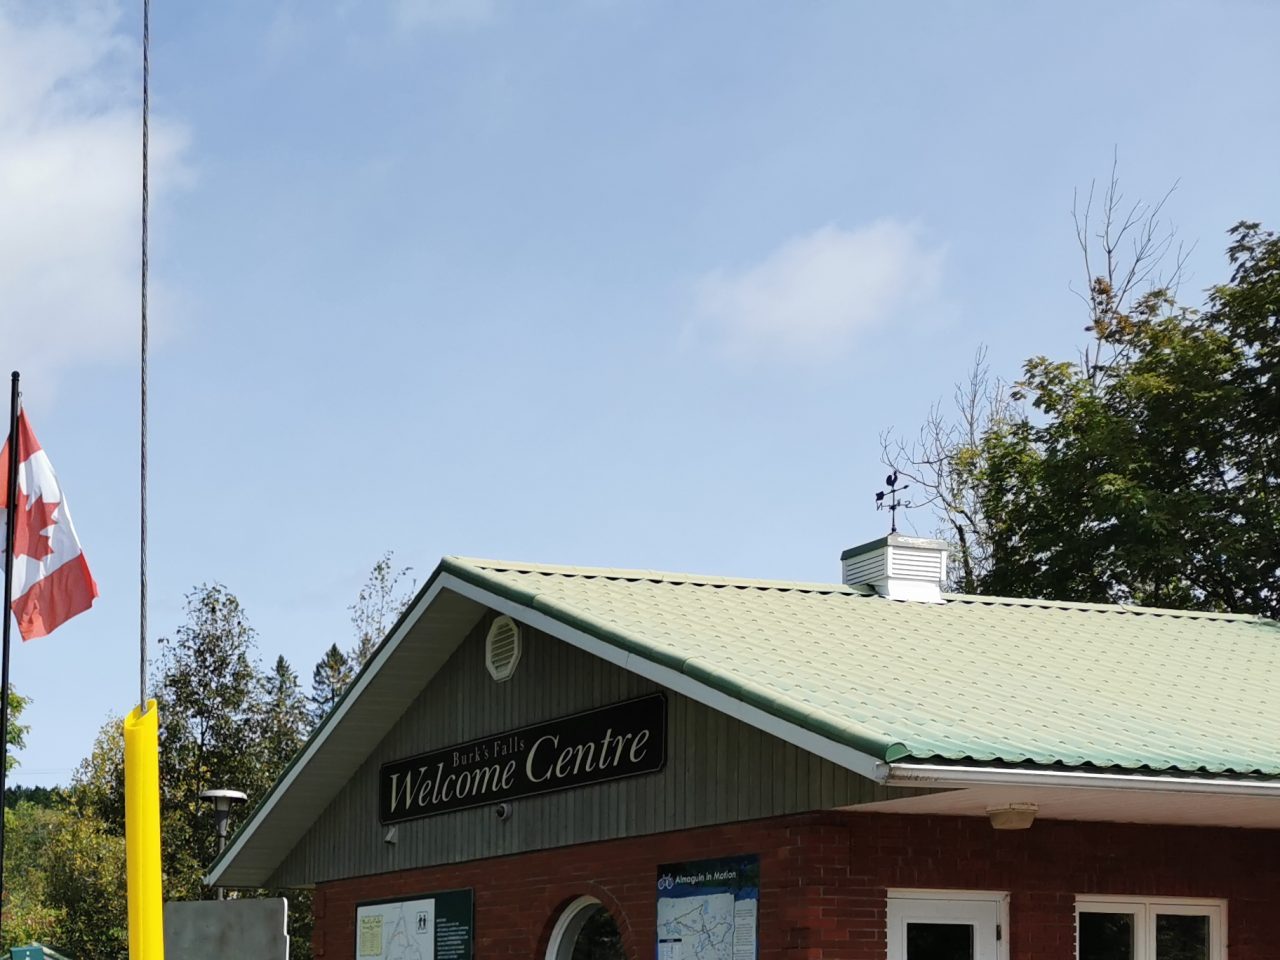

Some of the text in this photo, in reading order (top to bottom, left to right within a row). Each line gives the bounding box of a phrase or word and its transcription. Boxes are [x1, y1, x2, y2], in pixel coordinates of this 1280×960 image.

[453, 736, 525, 768] Burk's Falls
[389, 728, 650, 814] Welcome Centre
[713, 870, 737, 881] Motion
